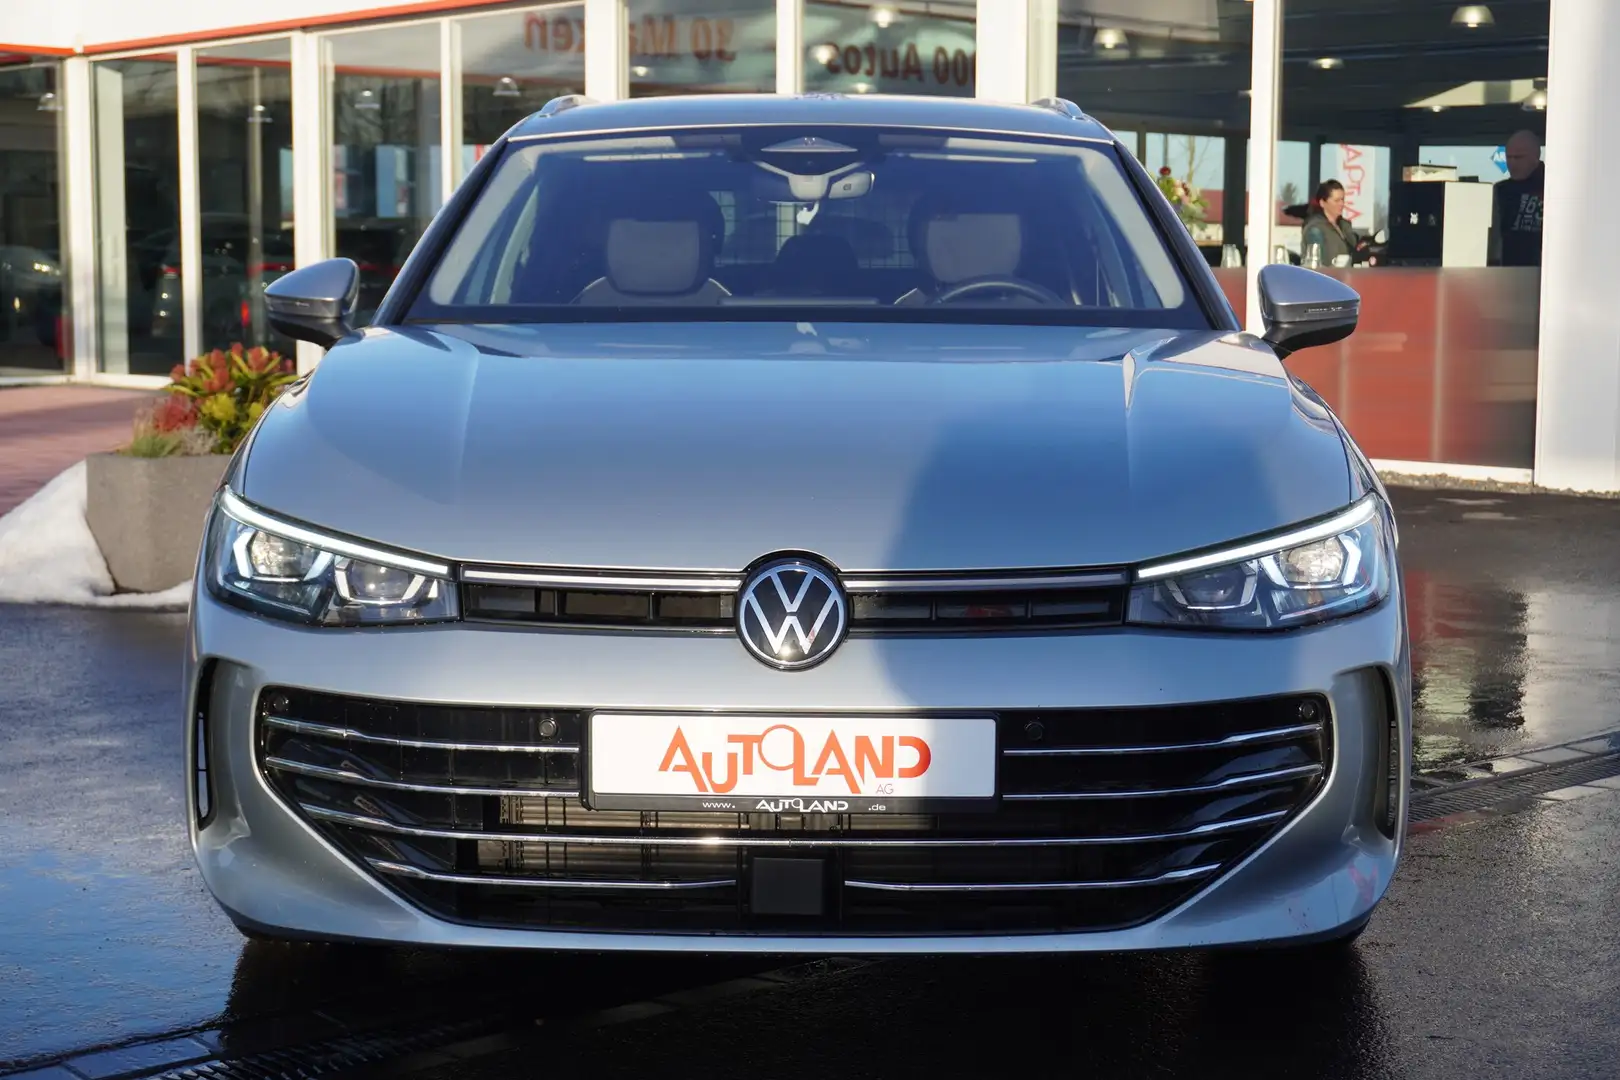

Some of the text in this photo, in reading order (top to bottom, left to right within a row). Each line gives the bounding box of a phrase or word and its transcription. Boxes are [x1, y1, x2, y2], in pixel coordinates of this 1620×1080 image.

[658, 724, 932, 794] AUTOLAND
[875, 783, 894, 795] AG
[702, 797, 887, 813] www. AUTOLAND .de
